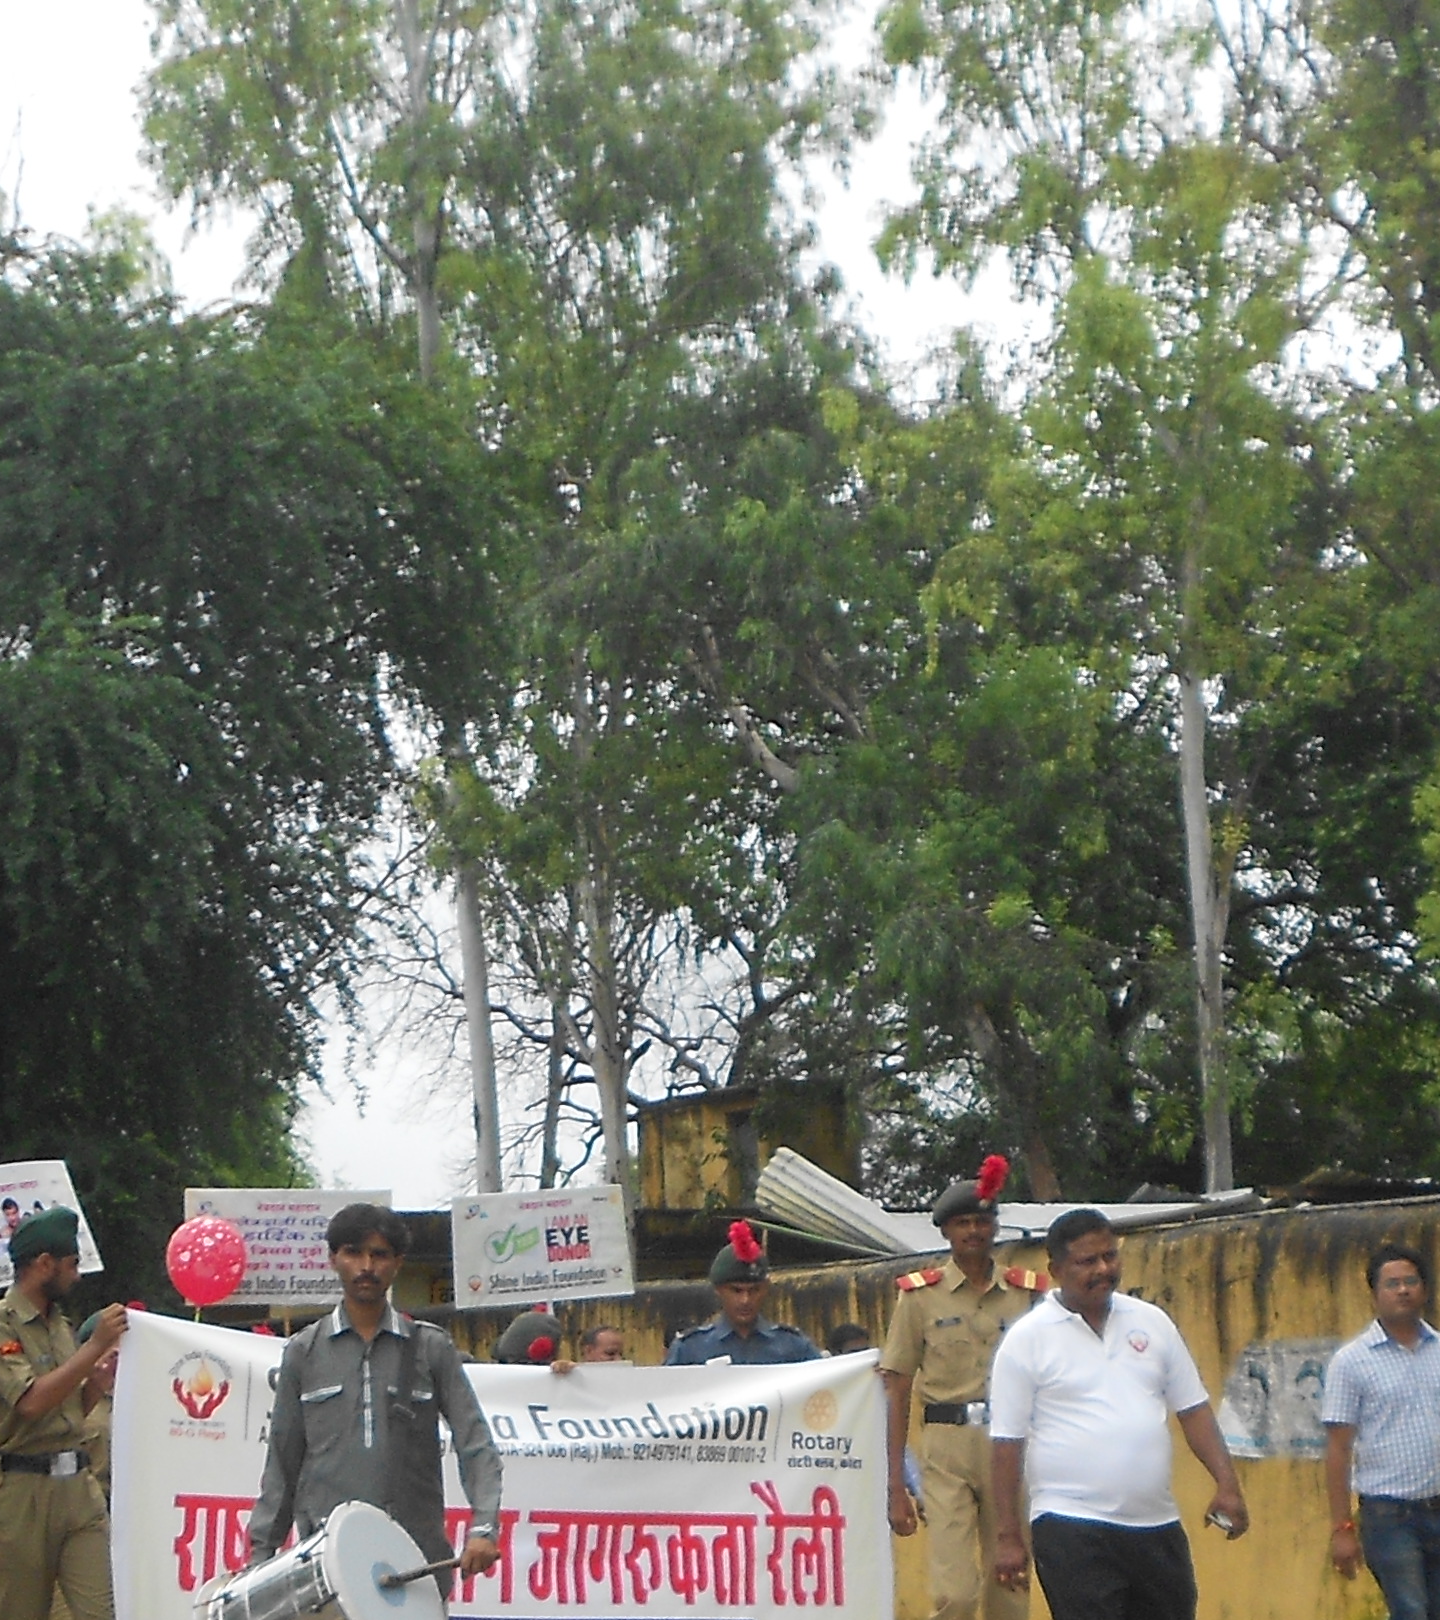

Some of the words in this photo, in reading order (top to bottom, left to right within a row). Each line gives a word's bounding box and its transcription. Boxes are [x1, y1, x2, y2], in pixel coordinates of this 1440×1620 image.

[545, 1226, 591, 1247] EYE
[526, 1401, 768, 1441] Foundation
[791, 1431, 853, 1455] Rotary
[751, 1480, 847, 1607] रैली
